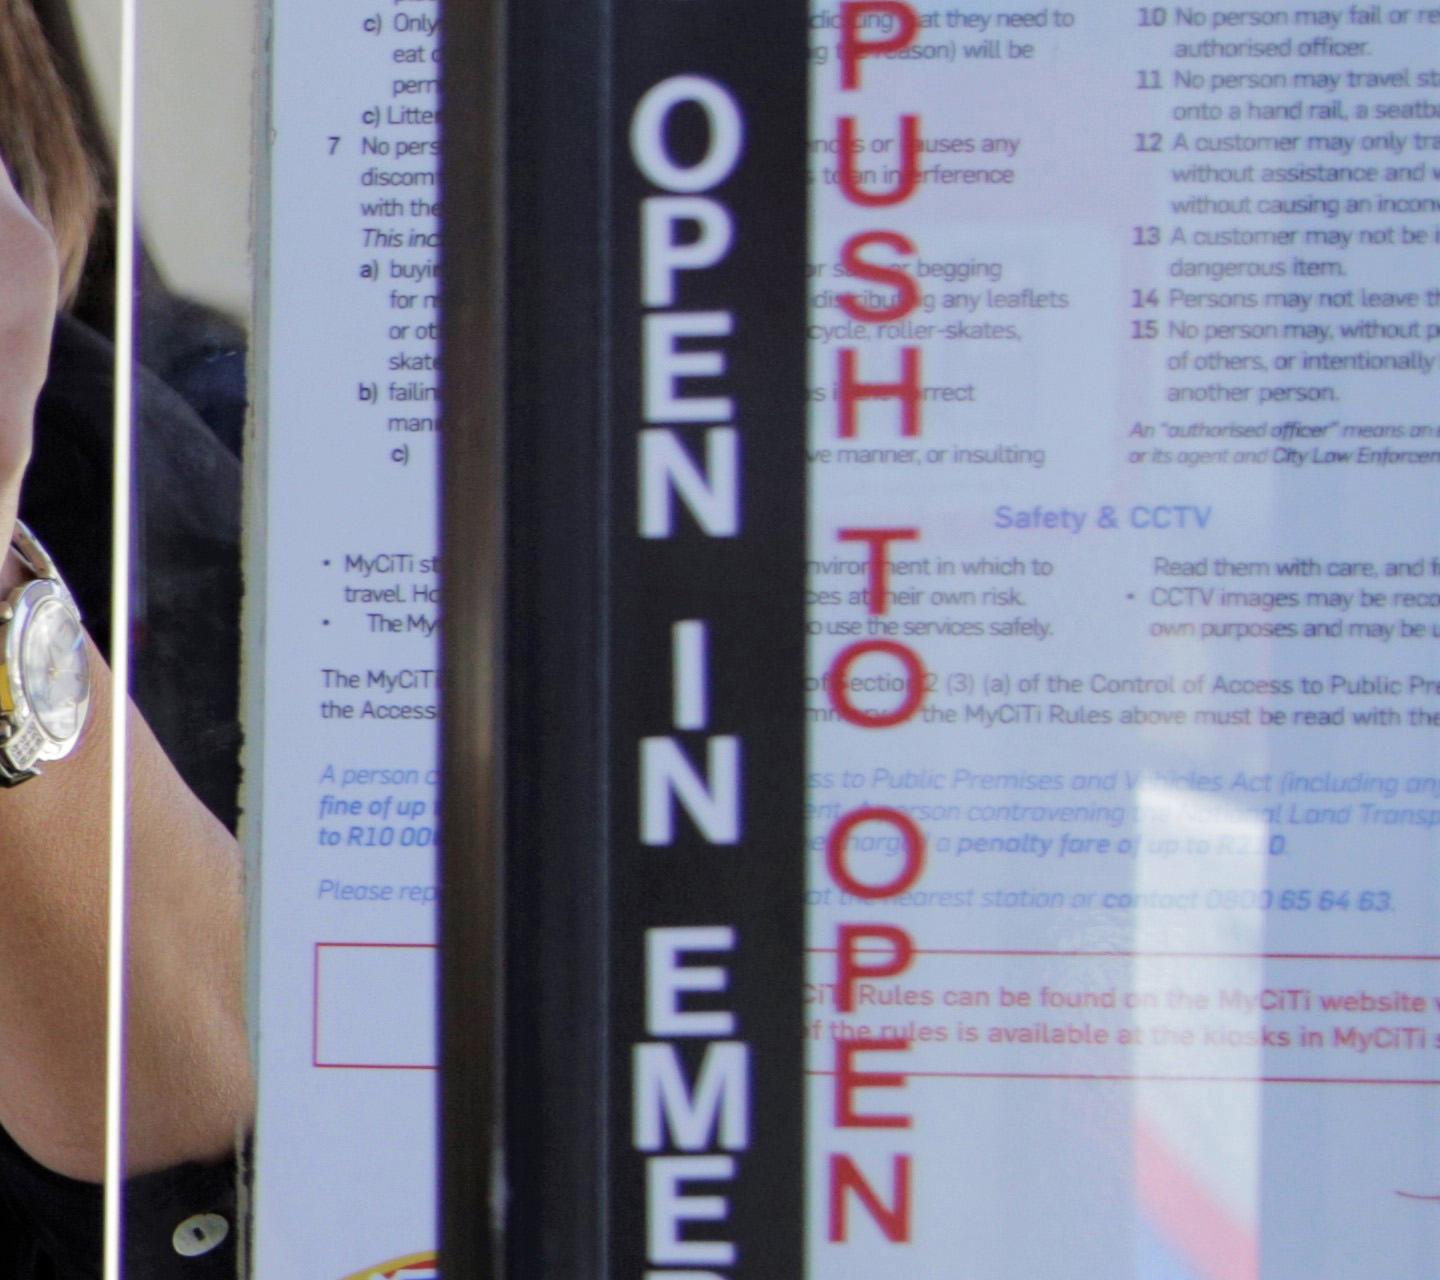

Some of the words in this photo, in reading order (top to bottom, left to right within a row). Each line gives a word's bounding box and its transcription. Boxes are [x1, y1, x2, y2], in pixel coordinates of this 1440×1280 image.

[363, 14, 382, 35] c)
[945, 9, 991, 32] they
[997, 9, 1047, 28] need
[1052, 10, 1075, 28] to
[1138, 7, 1167, 27] 10
[1175, 7, 1206, 26] No
[1212, 11, 1289, 30] person
[1294, 10, 1342, 30] may
[1348, 5, 1381, 25] fail
[1388, 10, 1411, 24] or
[393, 46, 425, 63] eat
[1175, 37, 1293, 58] authorised
[1298, 36, 1367, 57] officer.
[329, 136, 340, 155] 7
[362, 137, 390, 155] No
[361, 198, 404, 217] with
[363, 228, 403, 248] This
[389, 290, 418, 309] for
[628, 75, 742, 538] OPEN
[359, 383, 378, 403] b)
[1168, 383, 1253, 402] another
[1260, 387, 1338, 403] person.
[994, 505, 1086, 534] Safety
[1097, 505, 1118, 529] &
[1130, 505, 1211, 529] CCTV
[345, 554, 413, 577] MyCiTi
[344, 585, 406, 603] travel.
[367, 613, 403, 633] The
[827, 527, 925, 729] TO
[321, 669, 360, 688] The
[320, 700, 354, 719] the
[361, 700, 437, 720] Access
[639, 621, 740, 844] IN
[320, 764, 335, 783] A
[341, 769, 419, 788] person
[319, 795, 363, 819] fine
[368, 796, 393, 820] of
[396, 801, 426, 820] up
[319, 828, 342, 846] to
[347, 826, 395, 847] R10
[318, 879, 393, 901] Please
[1278, 889, 1312, 911] 65
[1317, 890, 1350, 911] 64
[858, 984, 933, 1006] Rules
[942, 990, 990, 1006] can
[1000, 986, 1031, 1007] be
[1037, 985, 1115, 1008] found
[825, 805, 926, 1242] OPEN
